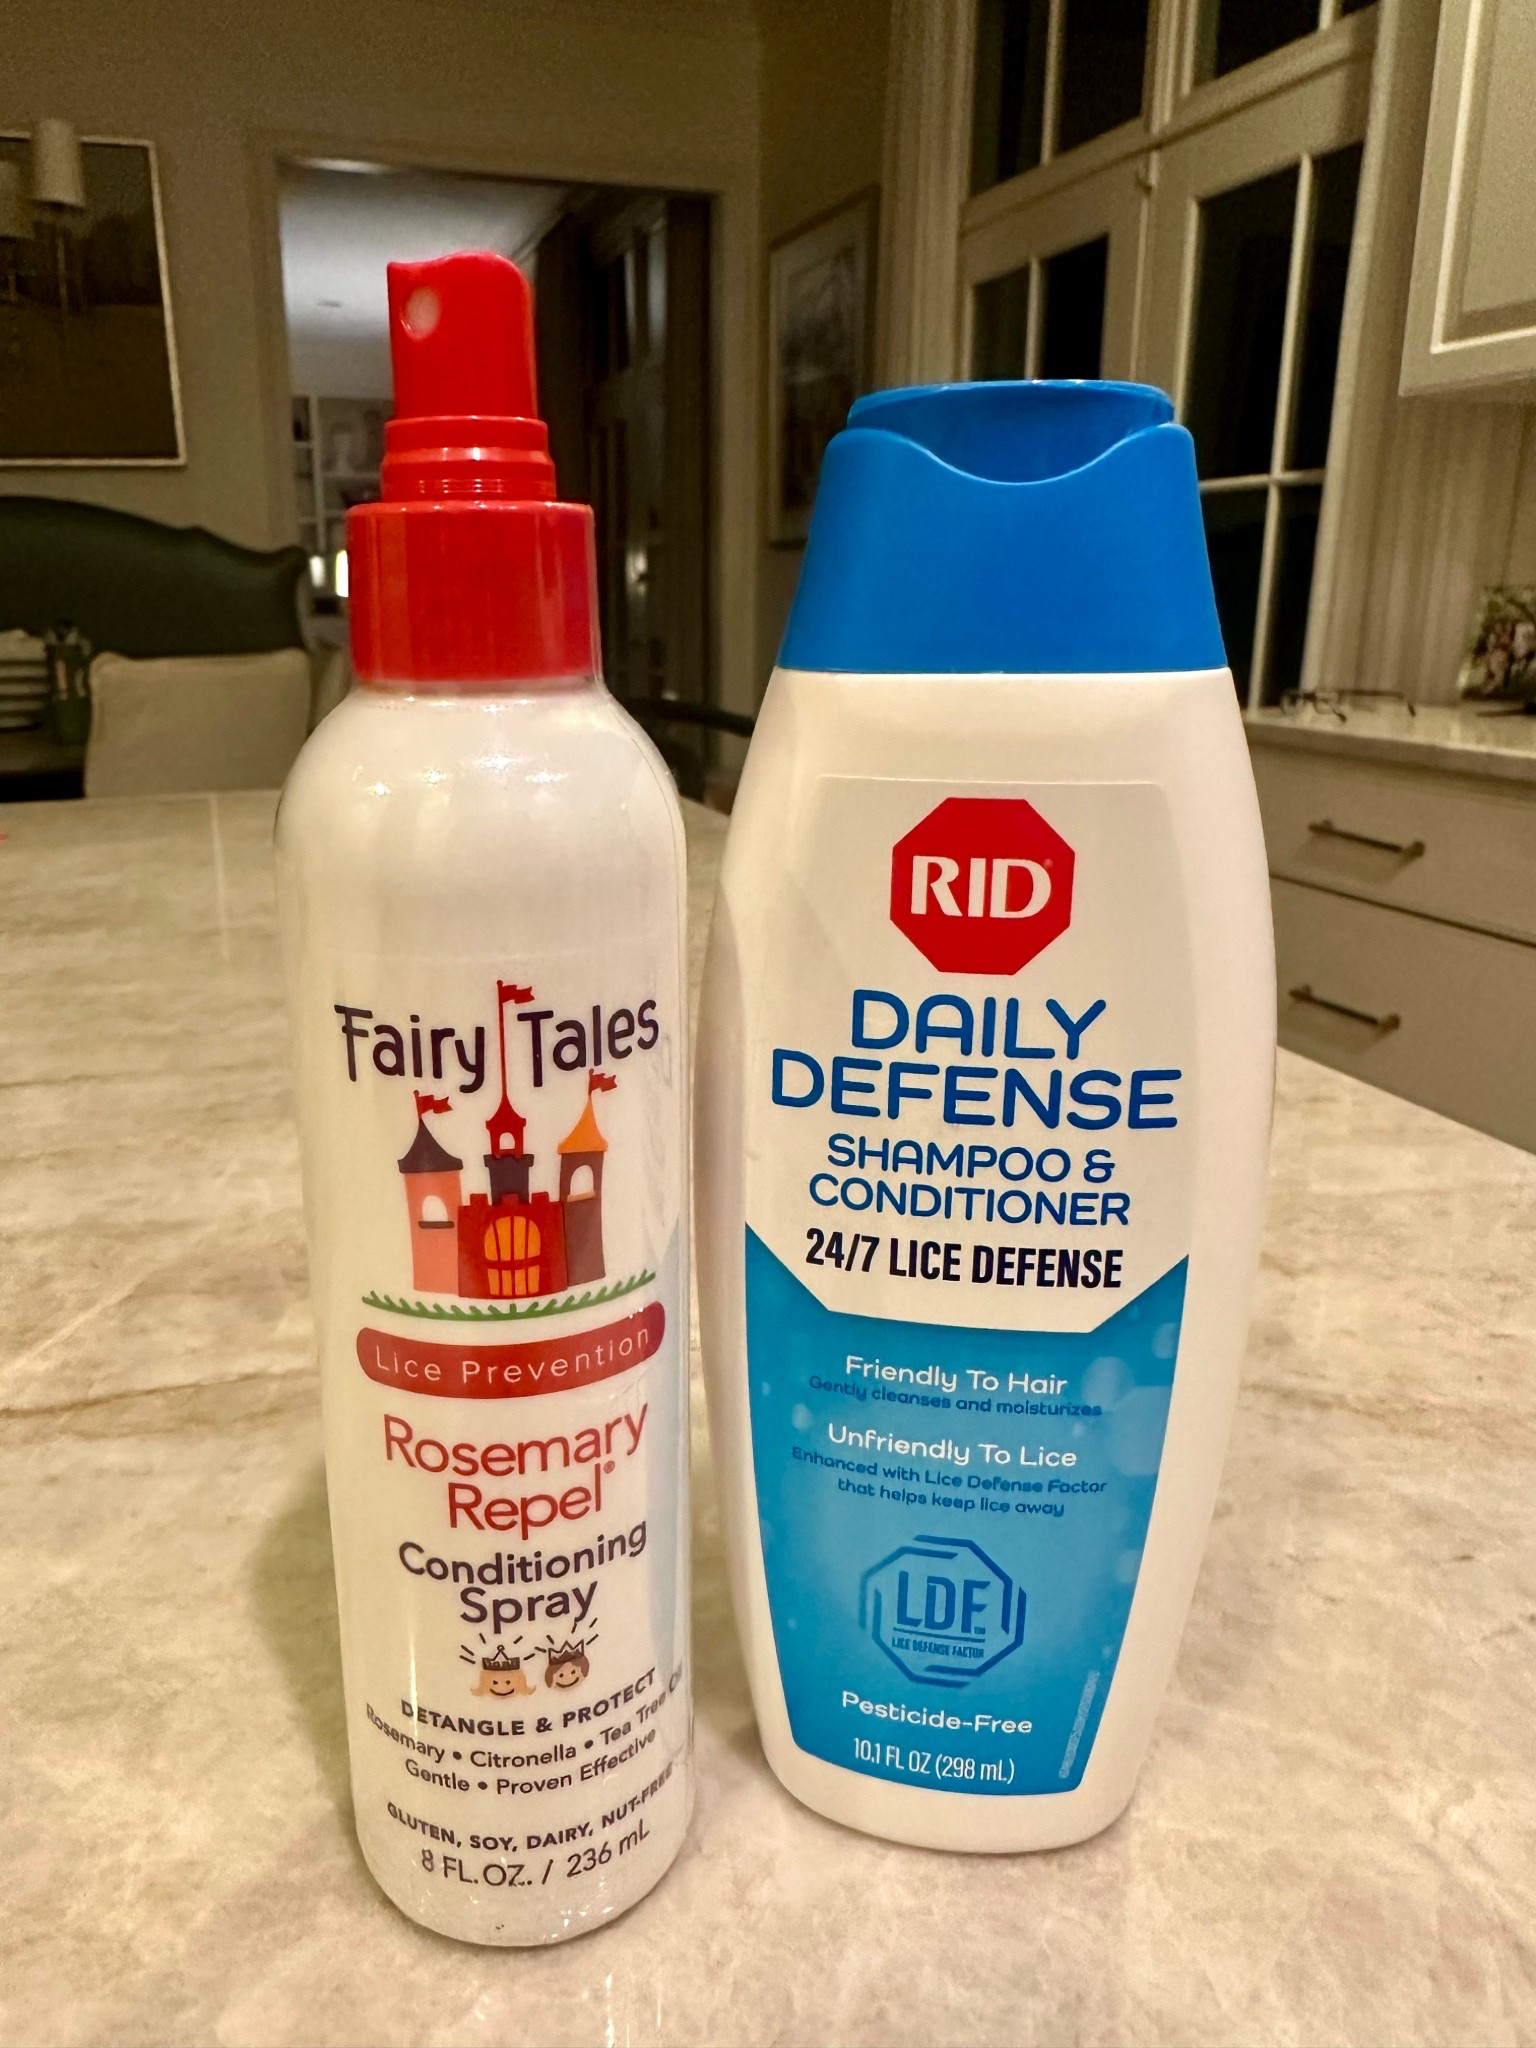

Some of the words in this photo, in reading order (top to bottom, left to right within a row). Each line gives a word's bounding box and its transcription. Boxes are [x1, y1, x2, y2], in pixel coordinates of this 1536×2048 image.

[334, 1004, 485, 1093] Fairy
[517, 999, 659, 1087] Tales
[852, 989, 1106, 1060] DAILY
[772, 1048, 1182, 1130] DEFENSE
[828, 1133, 1071, 1183] SHAMPOO
[1083, 1149, 1115, 1184] &
[809, 1173, 1131, 1226] CONDITIONER
[805, 1227, 880, 1273] 24/7
[889, 1238, 962, 1282] LICE
[971, 1245, 1123, 1289] DEFENSE
[376, 1345, 441, 1381] Lice
[462, 1328, 649, 1384] Prevention
[846, 1355, 957, 1392] Friendly
[966, 1369, 999, 1391] To
[1008, 1373, 1068, 1395] Hair
[809, 1375, 867, 1401] Gently
[871, 1386, 951, 1409] cleanses
[956, 1397, 992, 1413] and
[996, 1400, 1103, 1416] moisturizes
[384, 1402, 648, 1476] Rosemary
[828, 1423, 970, 1466] Unfriendly
[978, 1443, 1011, 1465] To
[1020, 1446, 1077, 1467] Lice
[792, 1446, 878, 1476] Enhanced
[882, 1463, 920, 1483] with
[925, 1470, 962, 1488] Lice
[967, 1475, 1043, 1493] Defense
[1048, 1479, 1107, 1495] Factor
[838, 1478, 876, 1497] that
[880, 1487, 927, 1506] helps
[931, 1494, 976, 1513] keep
[980, 1497, 1010, 1514] lice
[1014, 1502, 1065, 1518] away
[399, 1520, 647, 1586] Conditioning
[460, 1581, 598, 1634] Spray
[366, 1703, 446, 1764] Rosemary
[470, 1744, 577, 1768] Citronella
[600, 1721, 632, 1745] Tea
[636, 1692, 666, 1724] Tree
[401, 1699, 525, 1736] DETANGLE
[535, 1717, 553, 1733] &
[562, 1667, 656, 1728] PROTECT
[842, 1691, 1033, 1734] Pesticide-Free
[405, 1758, 470, 1792] Gentle
[496, 1773, 572, 1795] Proven
[580, 1729, 656, 1781] Effective
[854, 1738, 880, 1764] 10.1
[885, 1746, 904, 1770] FL
[909, 1751, 931, 1775] OZ
[935, 1754, 975, 1780] (298
[980, 1758, 1015, 1784] mL)
[387, 1801, 463, 1848] GLUTEN,
[470, 1835, 518, 1852] SOY,
[526, 1822, 594, 1850] DAIRY,
[602, 1762, 673, 1830] NUT-FREE
[421, 1848, 435, 1872] 8
[566, 1842, 612, 1878] 236
[619, 1818, 651, 1857] mL
